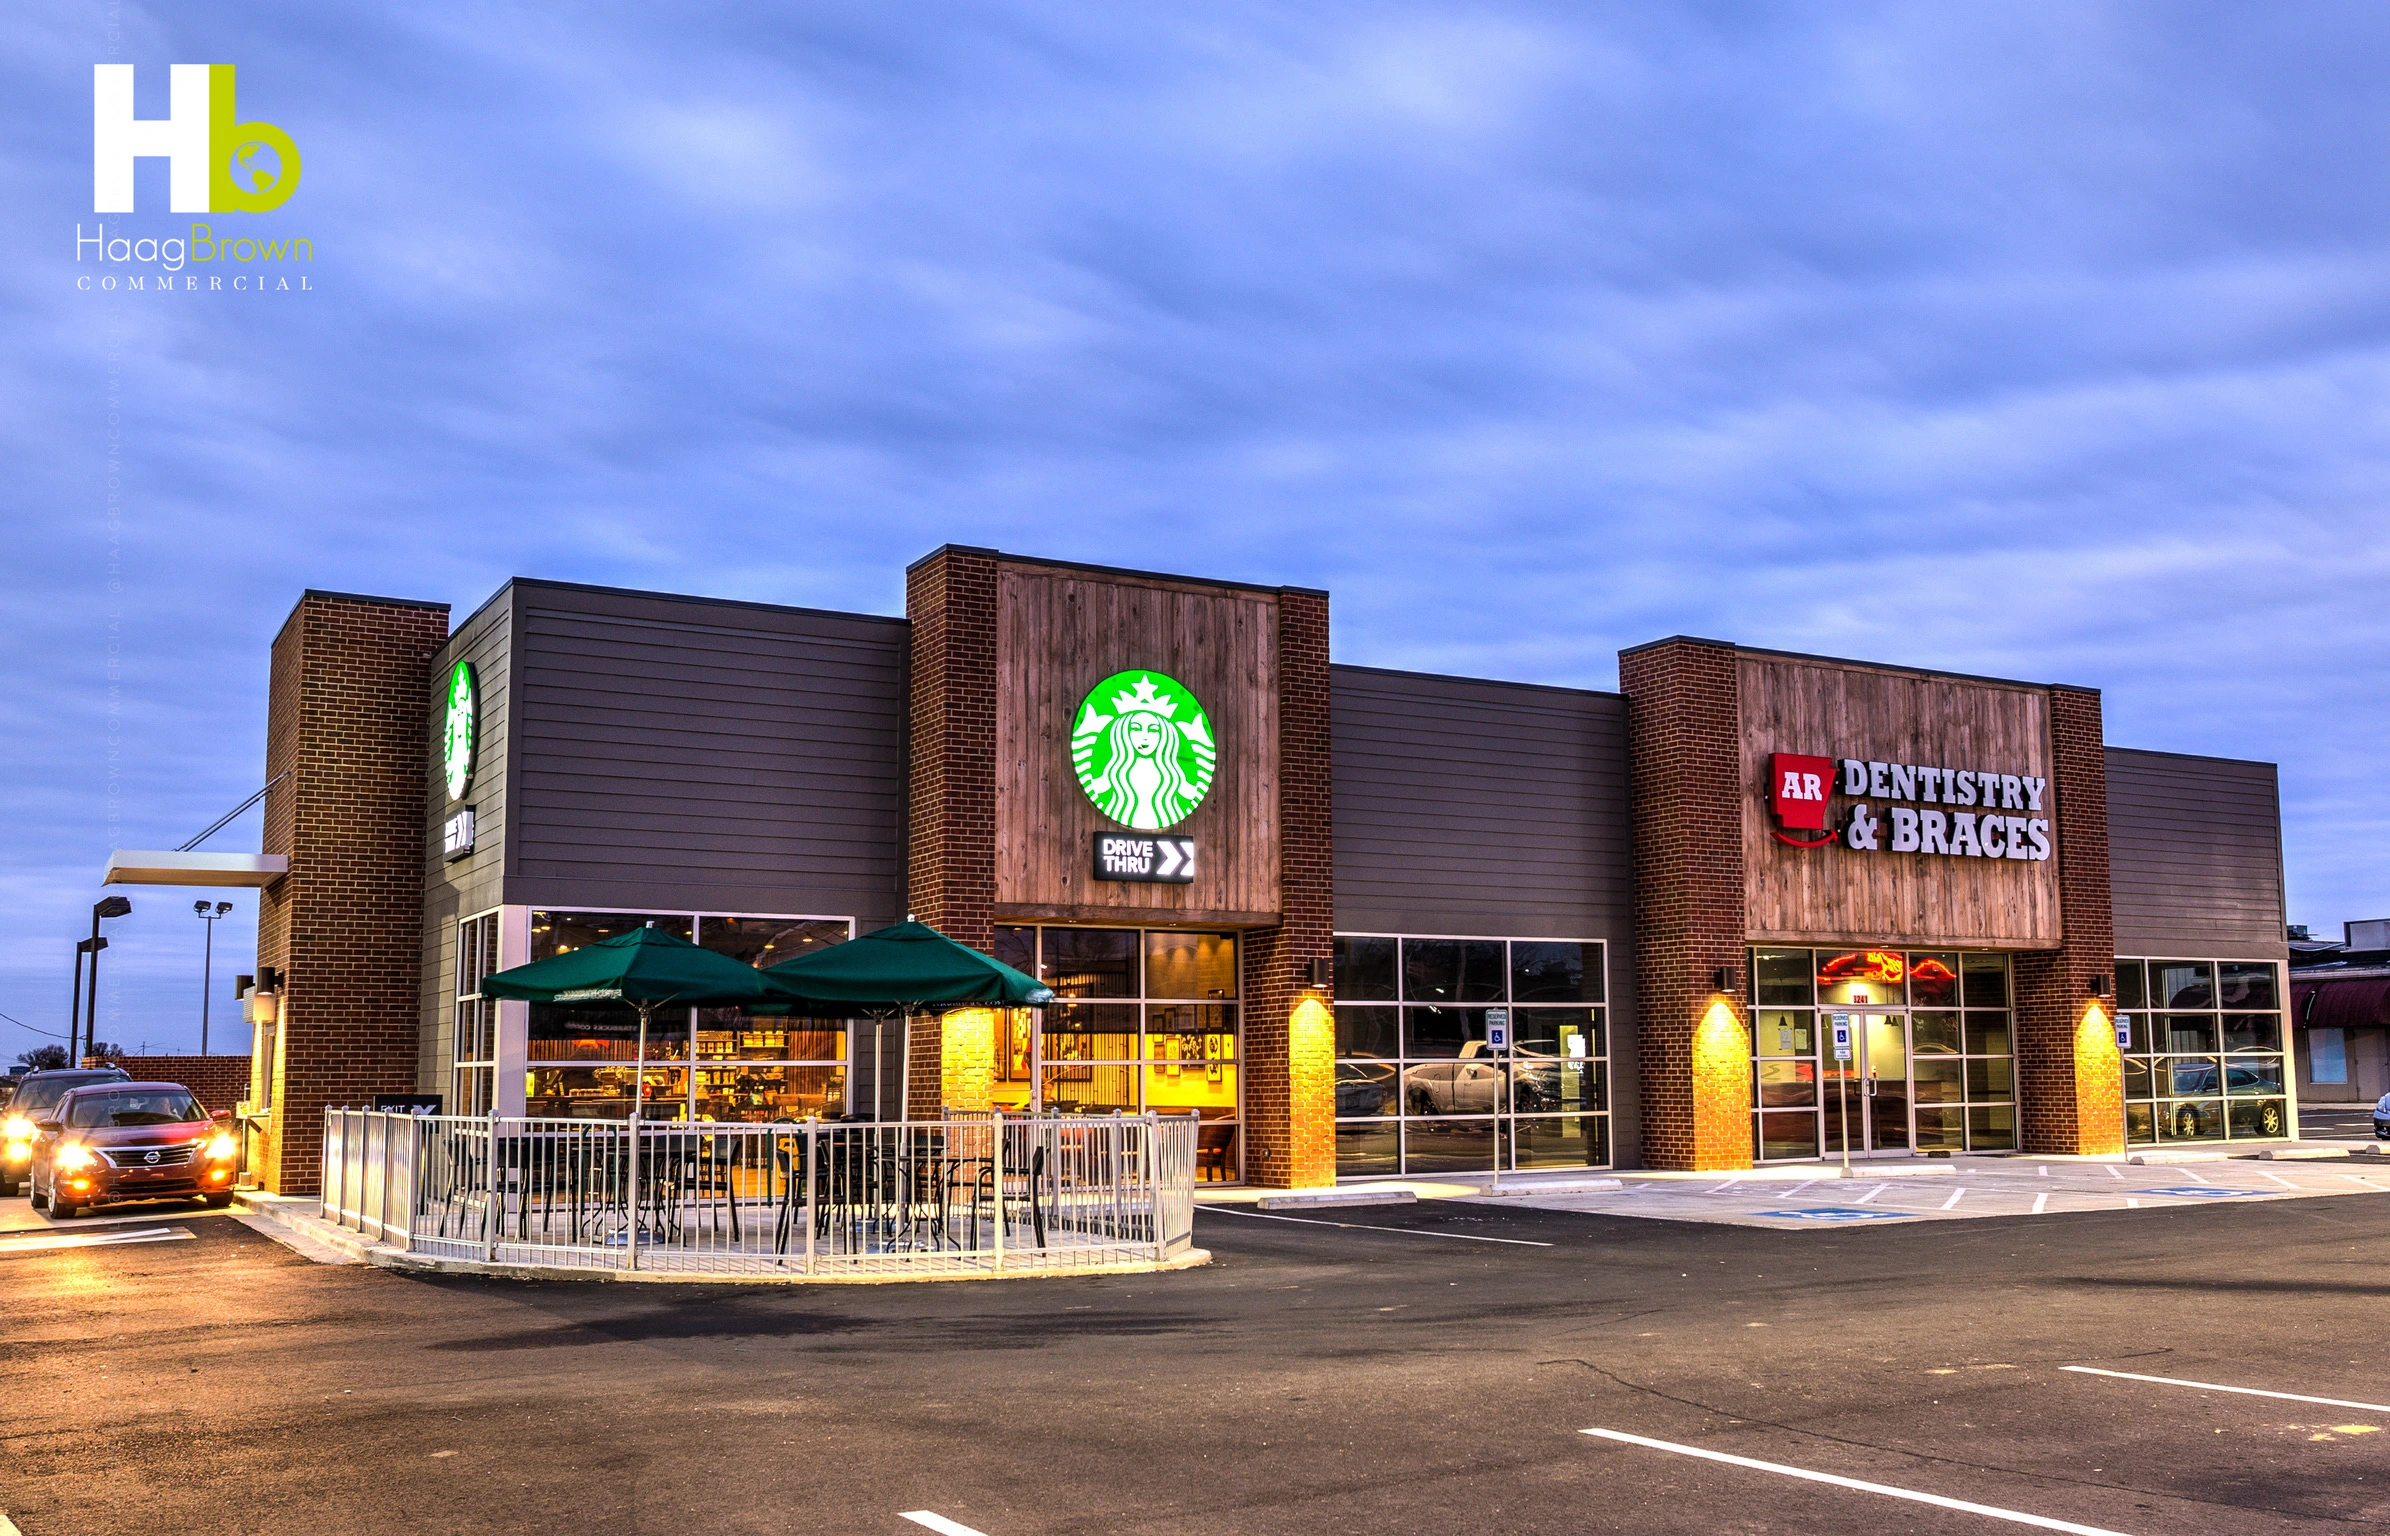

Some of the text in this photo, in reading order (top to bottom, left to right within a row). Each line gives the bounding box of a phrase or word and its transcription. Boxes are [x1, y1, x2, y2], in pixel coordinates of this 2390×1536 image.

[1781, 771, 1823, 801] AR
[1843, 758, 2046, 811] DENTISTRY
[1847, 803, 2051, 861] & BRACES
[1103, 839, 1154, 857] DRIVE
[1103, 855, 1150, 874] THRU
[1853, 995, 1868, 1003] 3241
[380, 1105, 406, 1113] EXIT
